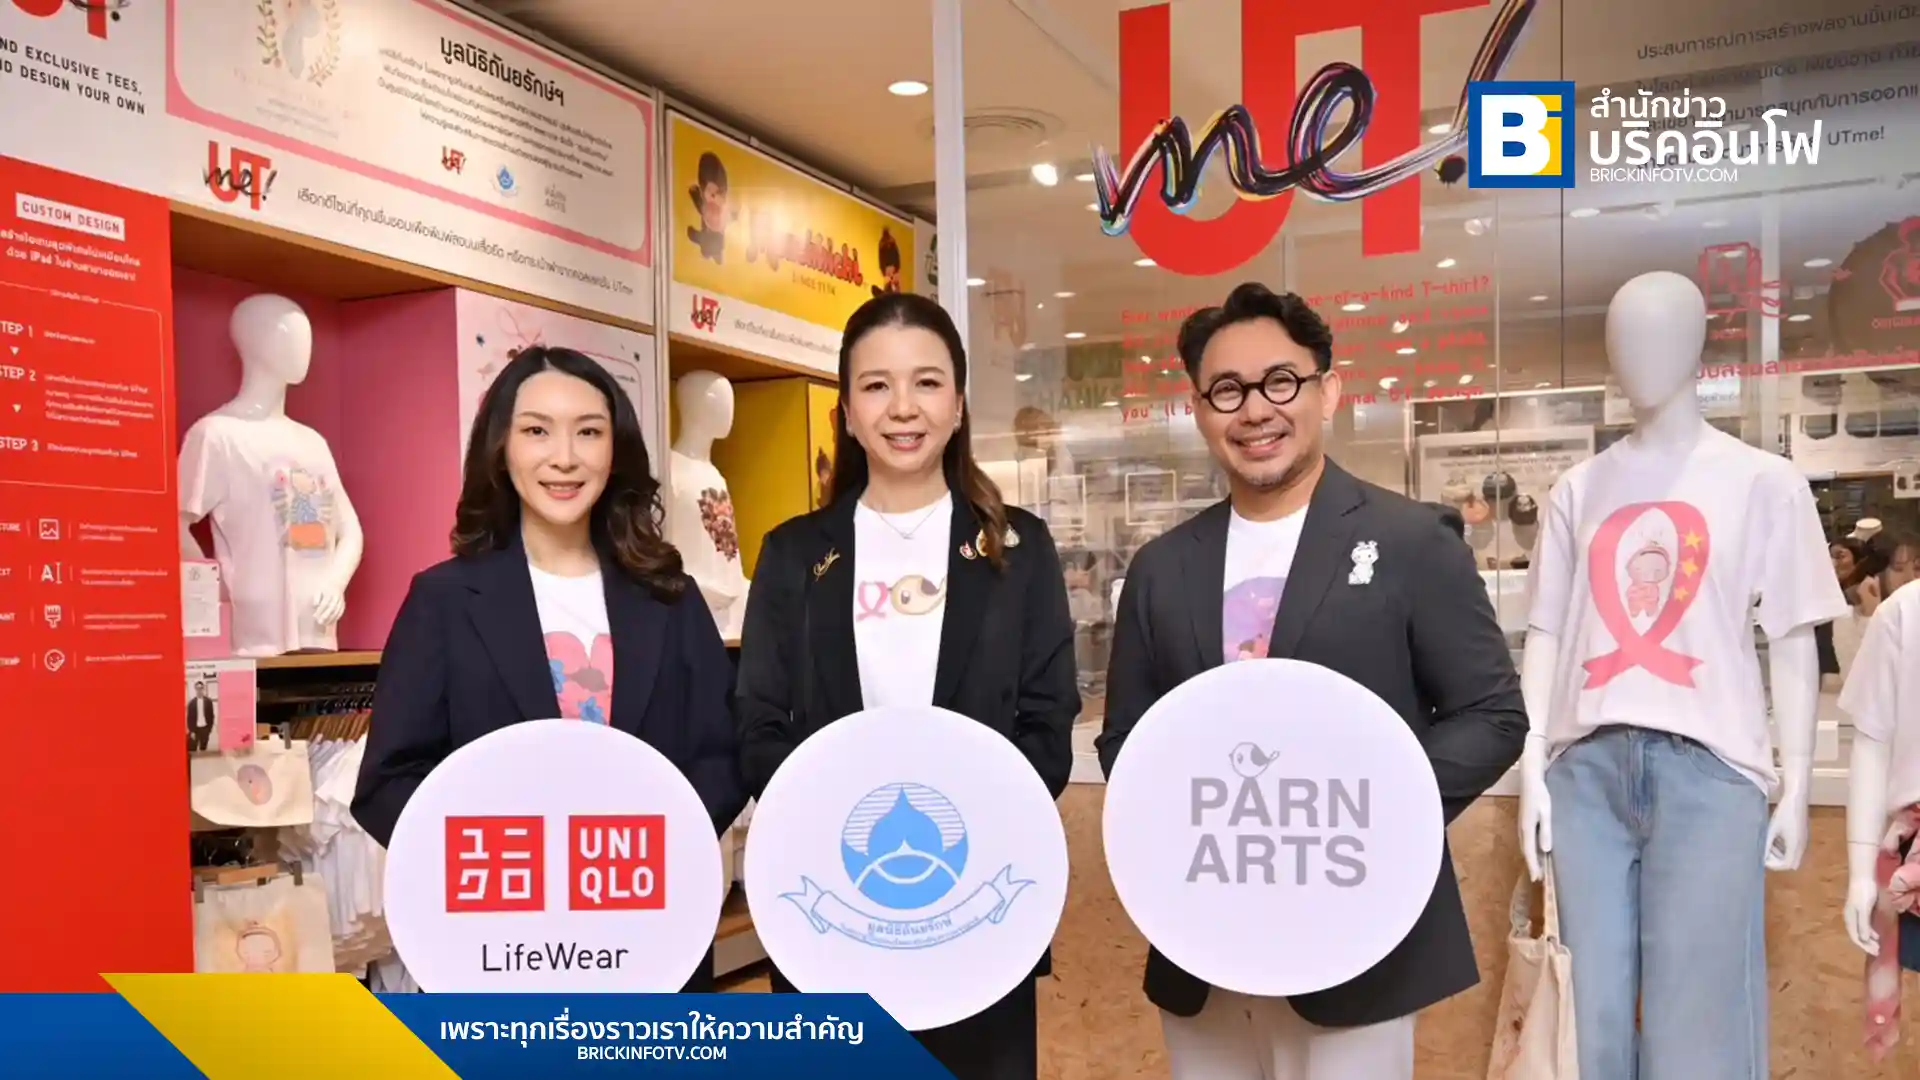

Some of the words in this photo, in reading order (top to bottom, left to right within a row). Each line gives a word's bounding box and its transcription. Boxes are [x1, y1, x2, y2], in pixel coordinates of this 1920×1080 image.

[26, 45, 99, 80] EXCLUSIVE
[106, 72, 142, 95] TEES,
[440, 36, 565, 107] มูลนิธิถันยรักษ์ฯ
[20, 65, 70, 91] DESIGN
[77, 83, 110, 104] YOUR
[117, 96, 145, 114] OWN
[1828, 126, 1886, 147] UTme!
[208, 140, 271, 211] UT
[22, 200, 72, 222] CUSTOM
[77, 213, 120, 234] DESIGN
[29, 369, 36, 381] 2
[31, 440, 38, 452] 3
[1190, 776, 1370, 829] PARN
[579, 826, 648, 860] UNI
[1185, 833, 1368, 888] ARTS
[579, 866, 655, 904] QLO
[482, 942, 629, 972] LifeWear
